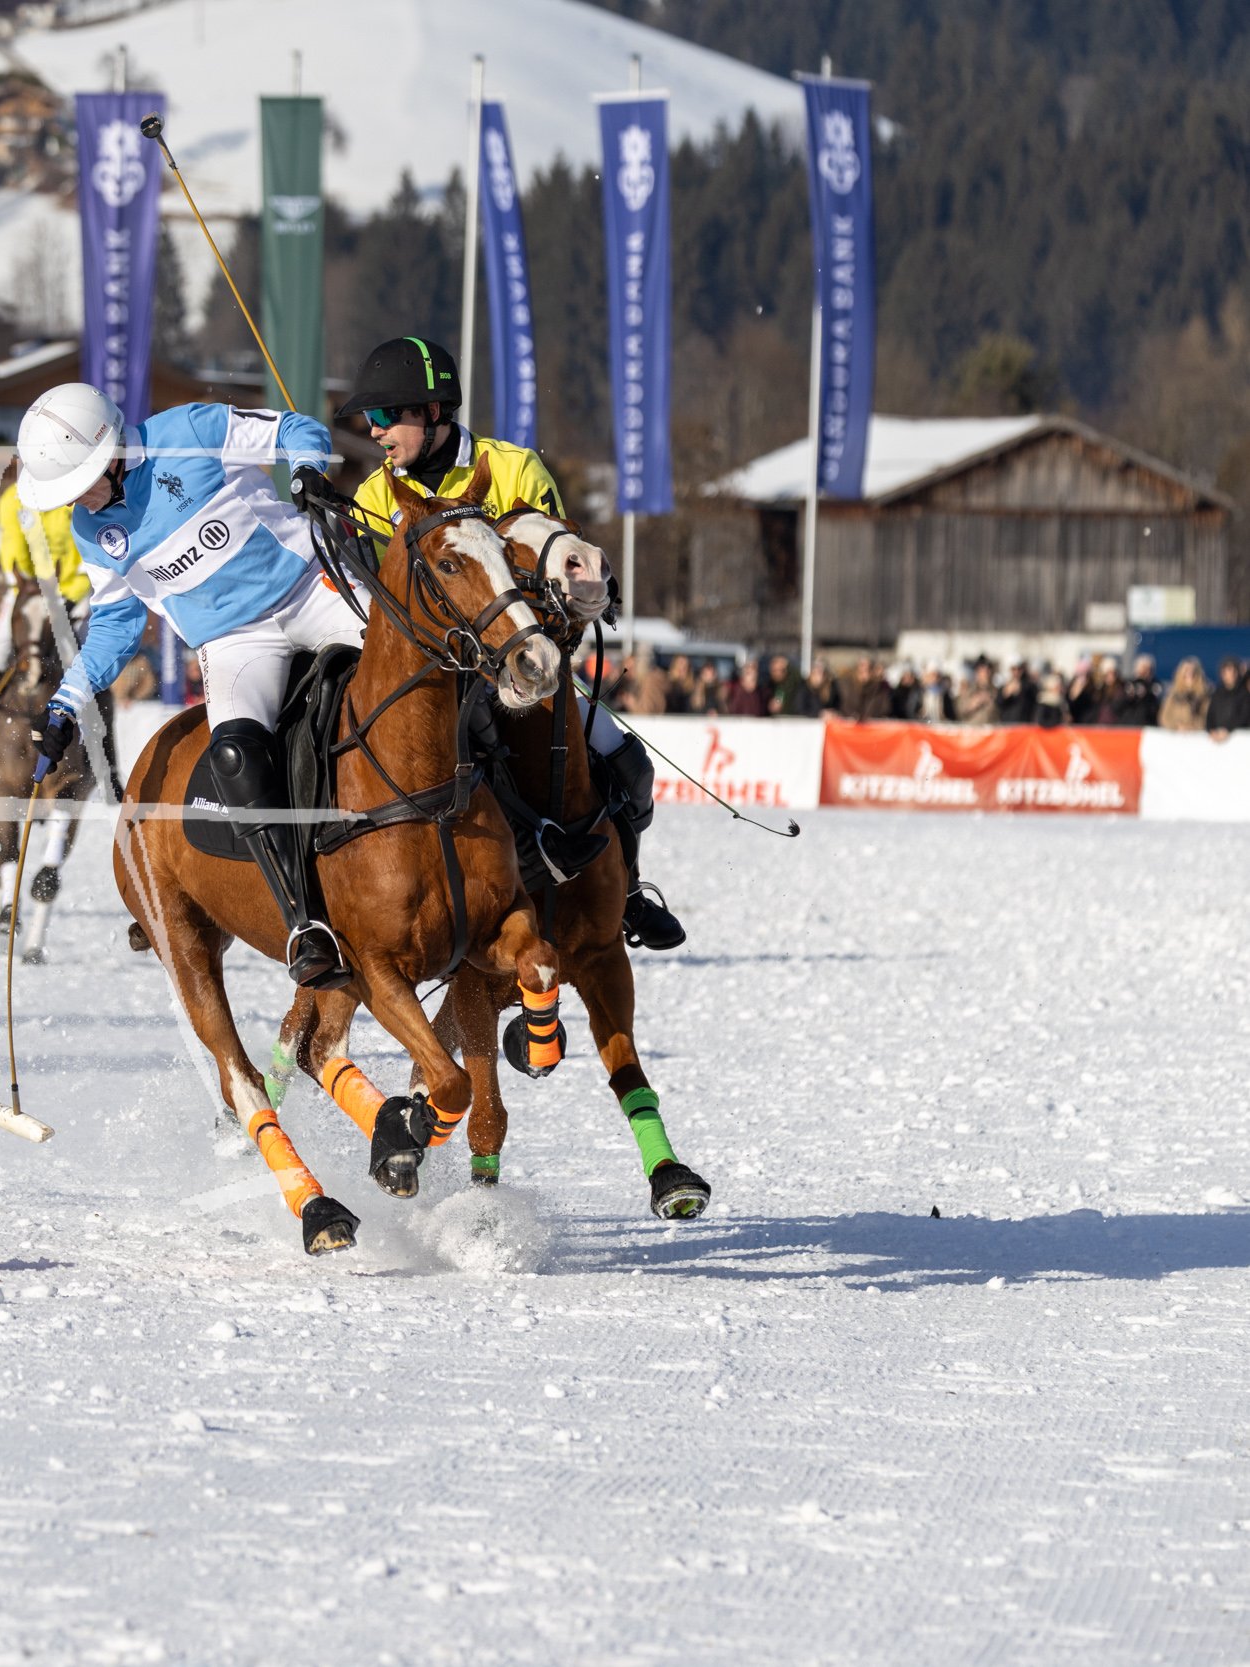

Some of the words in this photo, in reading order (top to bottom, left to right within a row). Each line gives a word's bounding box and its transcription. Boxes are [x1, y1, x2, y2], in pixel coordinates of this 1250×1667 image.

[105, 228, 131, 325] BANK
[176, 497, 194, 513] USPA
[441, 506, 475, 518] STANDING
[191, 796, 220, 812] Allianz
